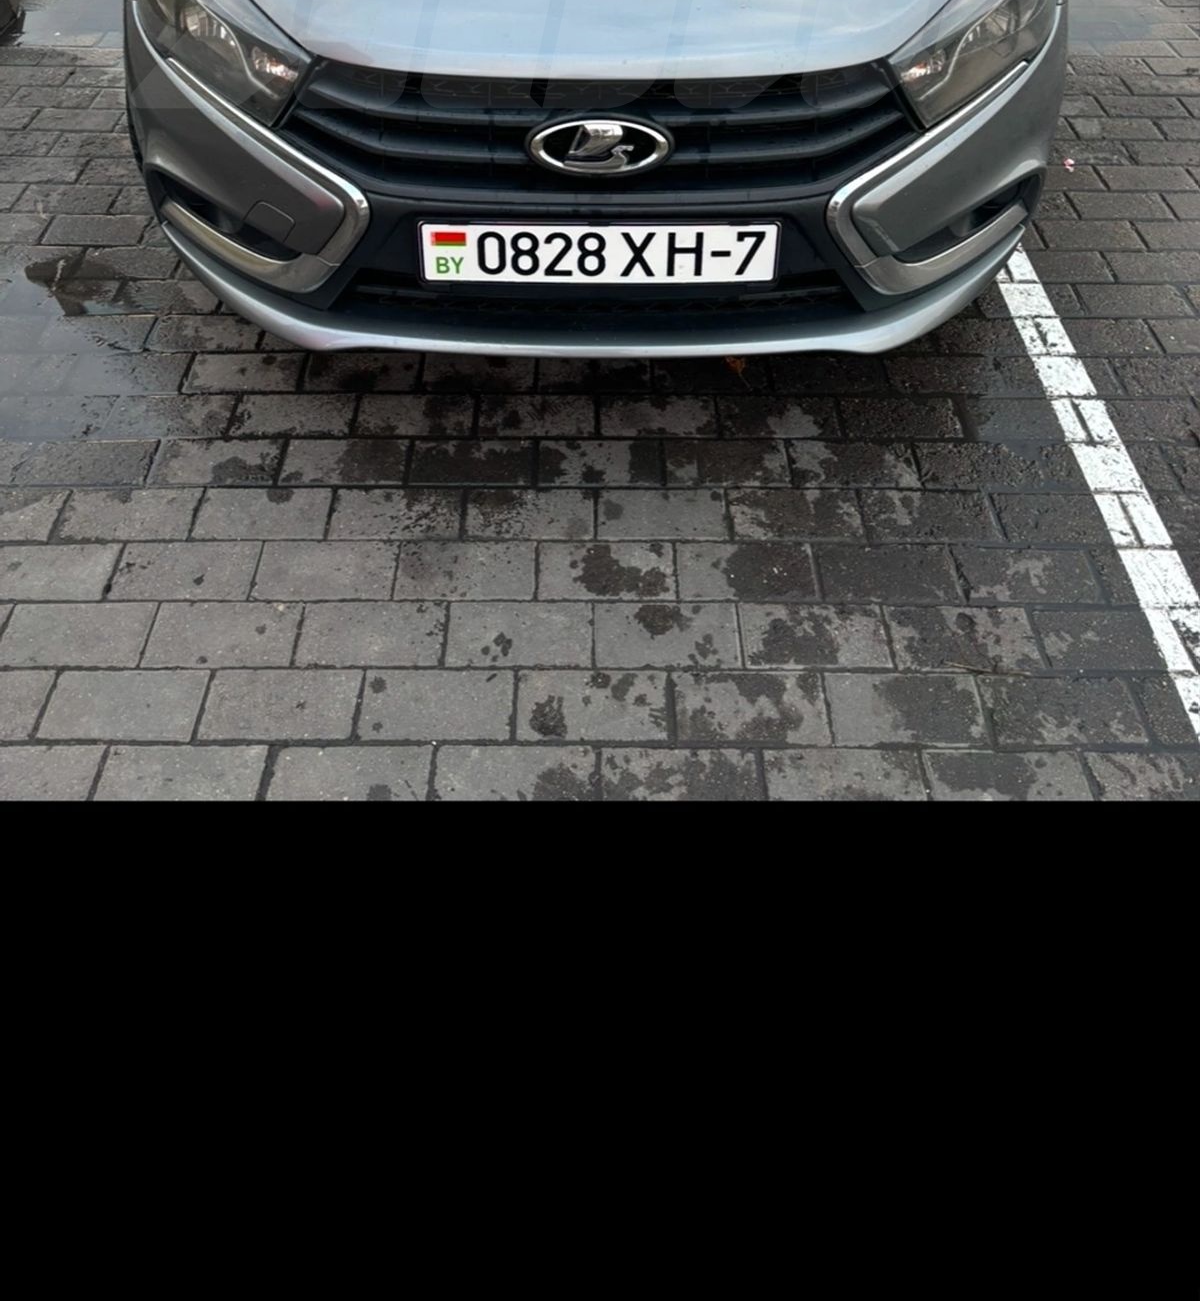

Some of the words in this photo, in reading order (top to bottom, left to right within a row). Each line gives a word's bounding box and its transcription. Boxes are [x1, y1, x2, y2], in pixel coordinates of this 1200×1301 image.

[436, 256, 464, 274] BY
[477, 231, 607, 276] 0828
[620, 231, 767, 276] XH-7
